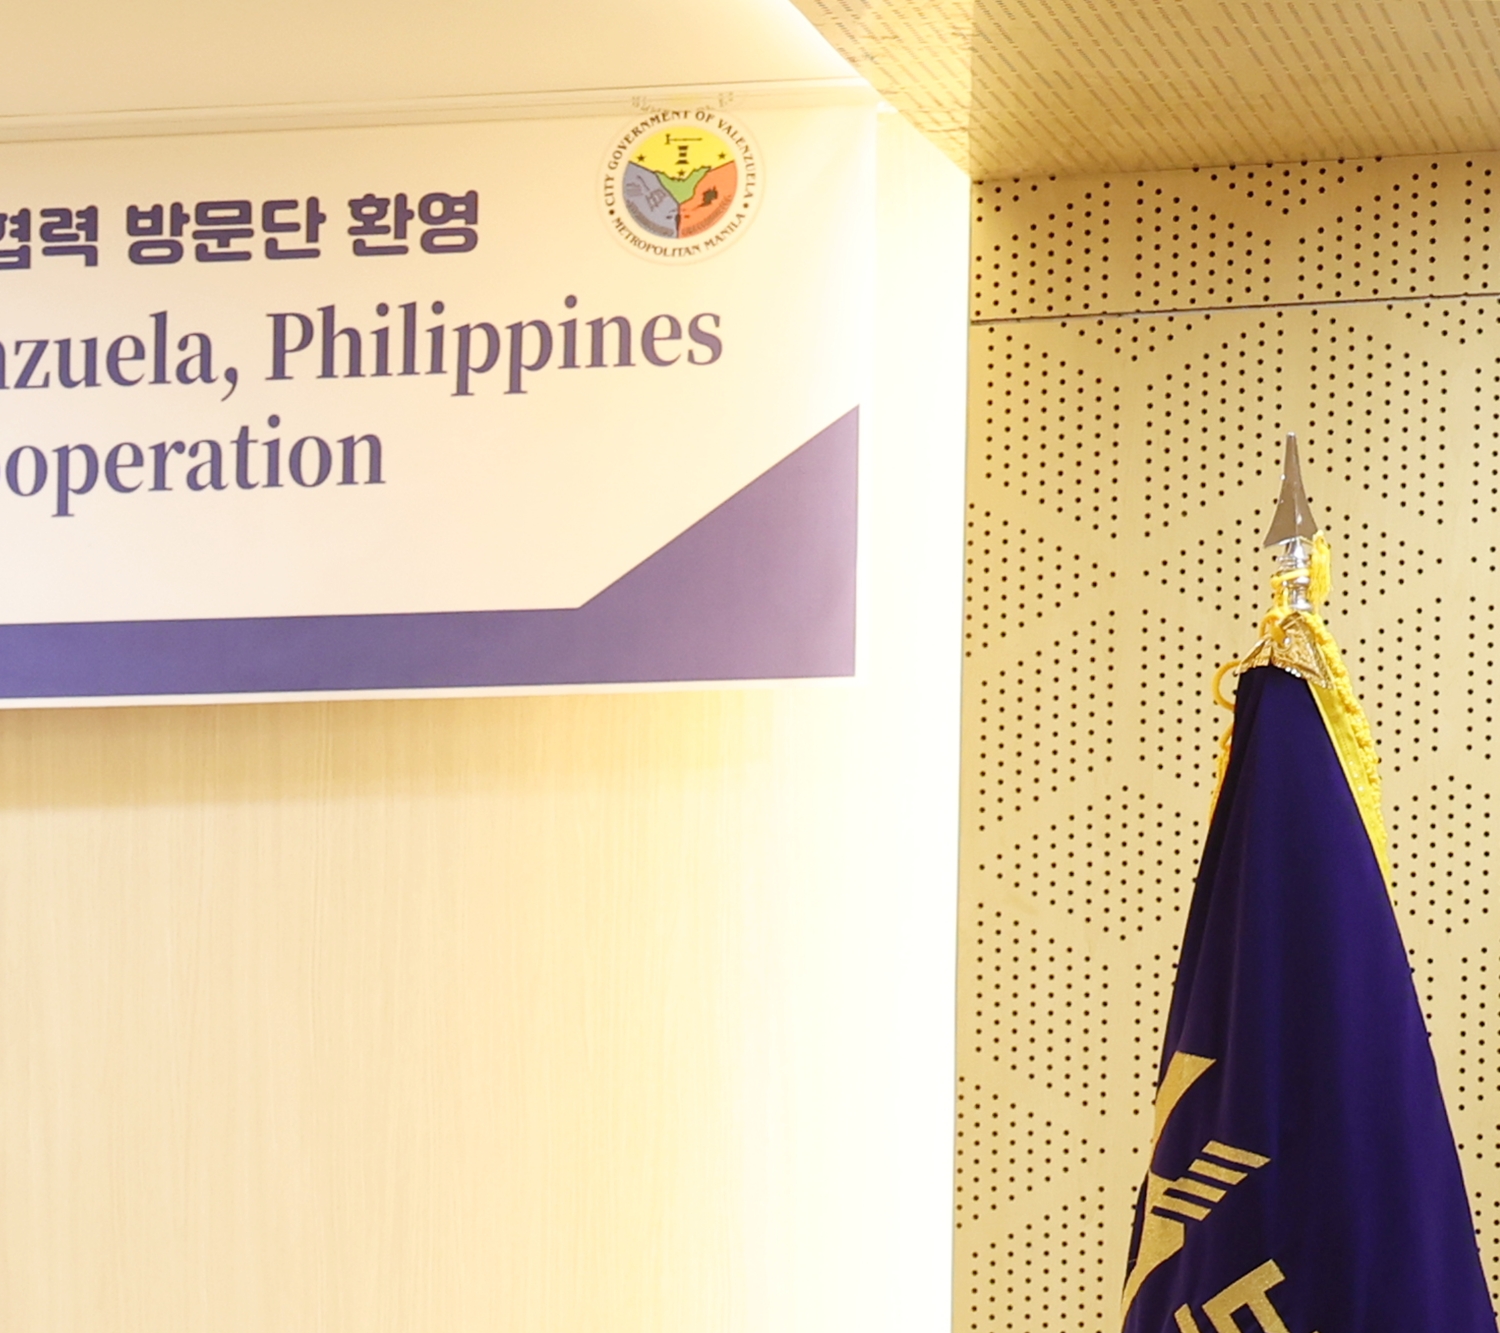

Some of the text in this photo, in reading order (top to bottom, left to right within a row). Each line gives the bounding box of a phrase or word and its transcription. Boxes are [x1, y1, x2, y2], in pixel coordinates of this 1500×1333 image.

[607, 110, 689, 171] GOVERNMENT
[695, 110, 716, 123] OF
[717, 118, 757, 199] VALENZUELA
[125, 196, 328, 265] 방문단
[346, 189, 480, 258] 환영
[611, 216, 702, 258] METROPOLITAN
[703, 212, 746, 250] MANILA
[264, 293, 725, 398] Philippines
